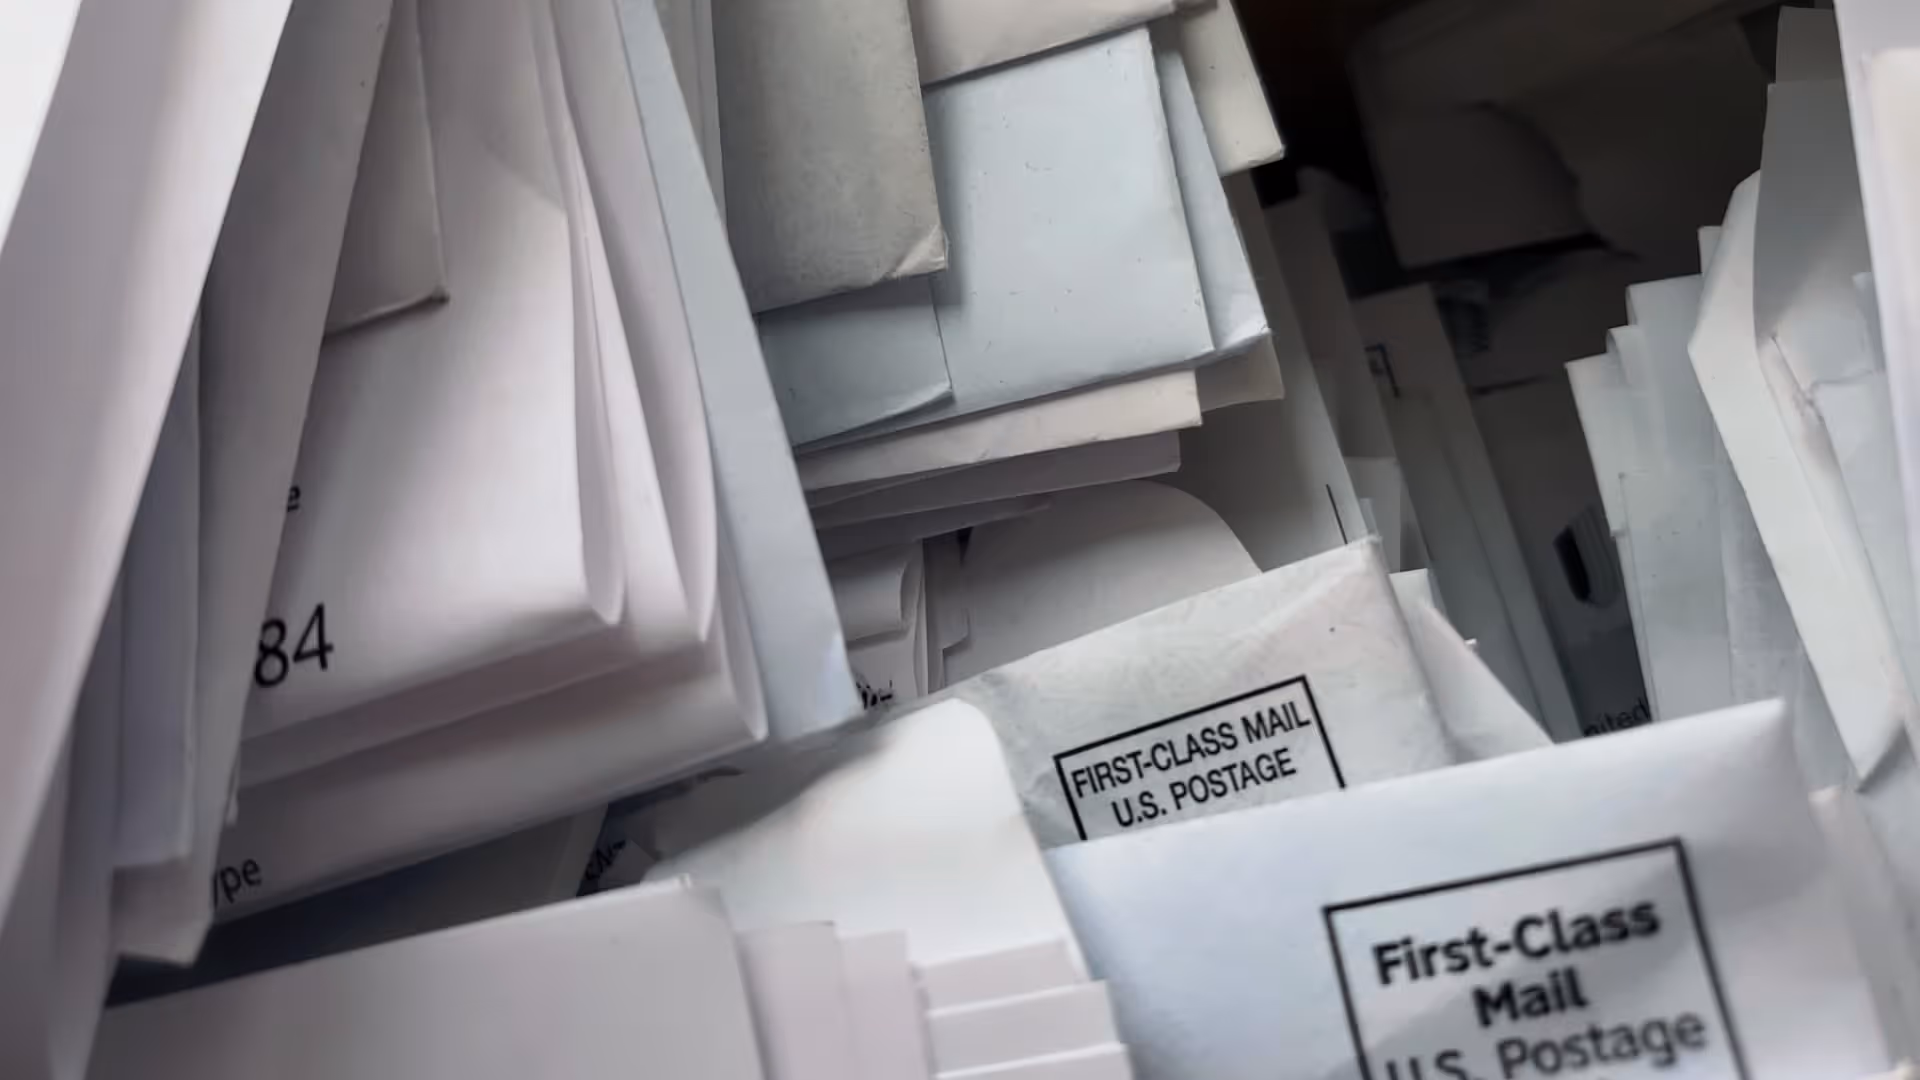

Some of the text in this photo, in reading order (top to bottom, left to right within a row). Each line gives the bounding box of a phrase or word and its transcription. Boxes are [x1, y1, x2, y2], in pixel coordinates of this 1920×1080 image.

[254, 602, 335, 688] 84
[1070, 700, 1312, 798] FIRST-CLASS MAIL
[1110, 747, 1297, 827] U.S. POSTAGE
[1371, 901, 1662, 986] First-Class
[1471, 967, 1592, 1028] Mail
[1495, 1012, 1708, 1080] Postage
